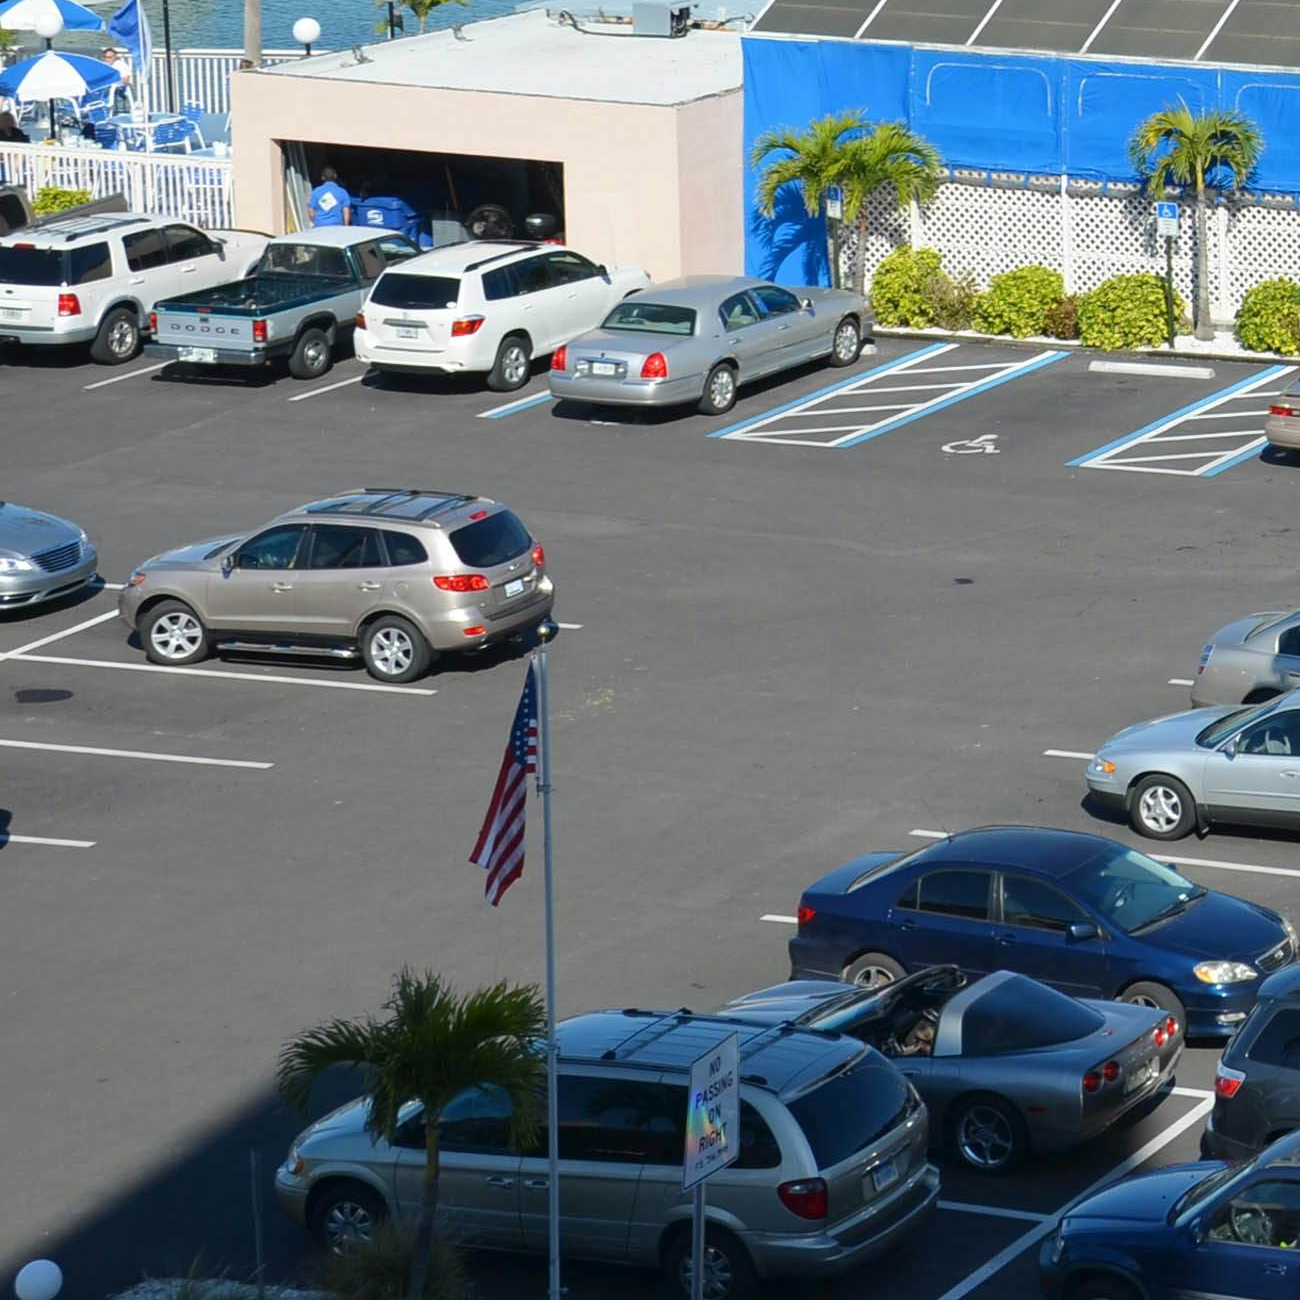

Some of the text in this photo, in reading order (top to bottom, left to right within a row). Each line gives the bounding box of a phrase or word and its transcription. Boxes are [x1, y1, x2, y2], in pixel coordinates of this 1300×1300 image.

[170, 323, 240, 335] DODGE
[709, 1056, 721, 1077] NO
[696, 1071, 733, 1110] PASSING
[708, 1103, 721, 1125] ON
[699, 1121, 728, 1153] RIGHT
